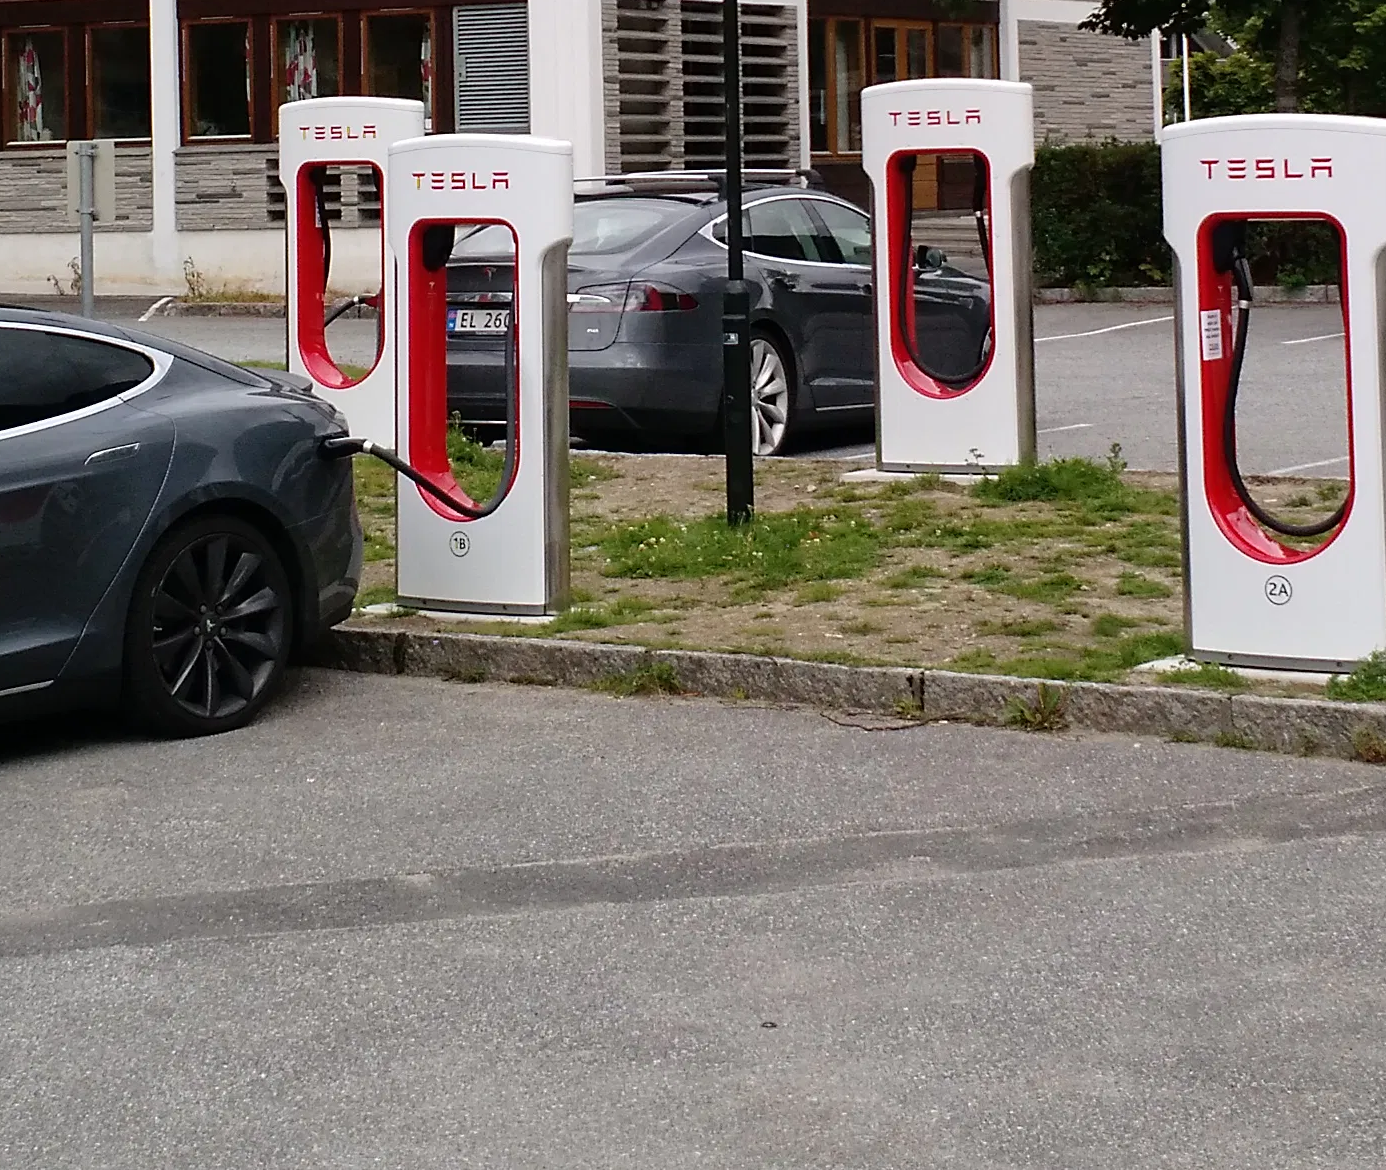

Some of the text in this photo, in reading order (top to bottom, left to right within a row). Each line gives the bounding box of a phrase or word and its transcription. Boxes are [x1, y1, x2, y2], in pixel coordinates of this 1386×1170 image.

[889, 110, 981, 126] TESLA
[300, 125, 377, 141] TESLA
[1200, 158, 1332, 179] TESLA
[412, 172, 510, 191] TESLA
[460, 312, 476, 328] EL
[453, 537, 466, 550] 1B
[1269, 582, 1289, 597] 2A
